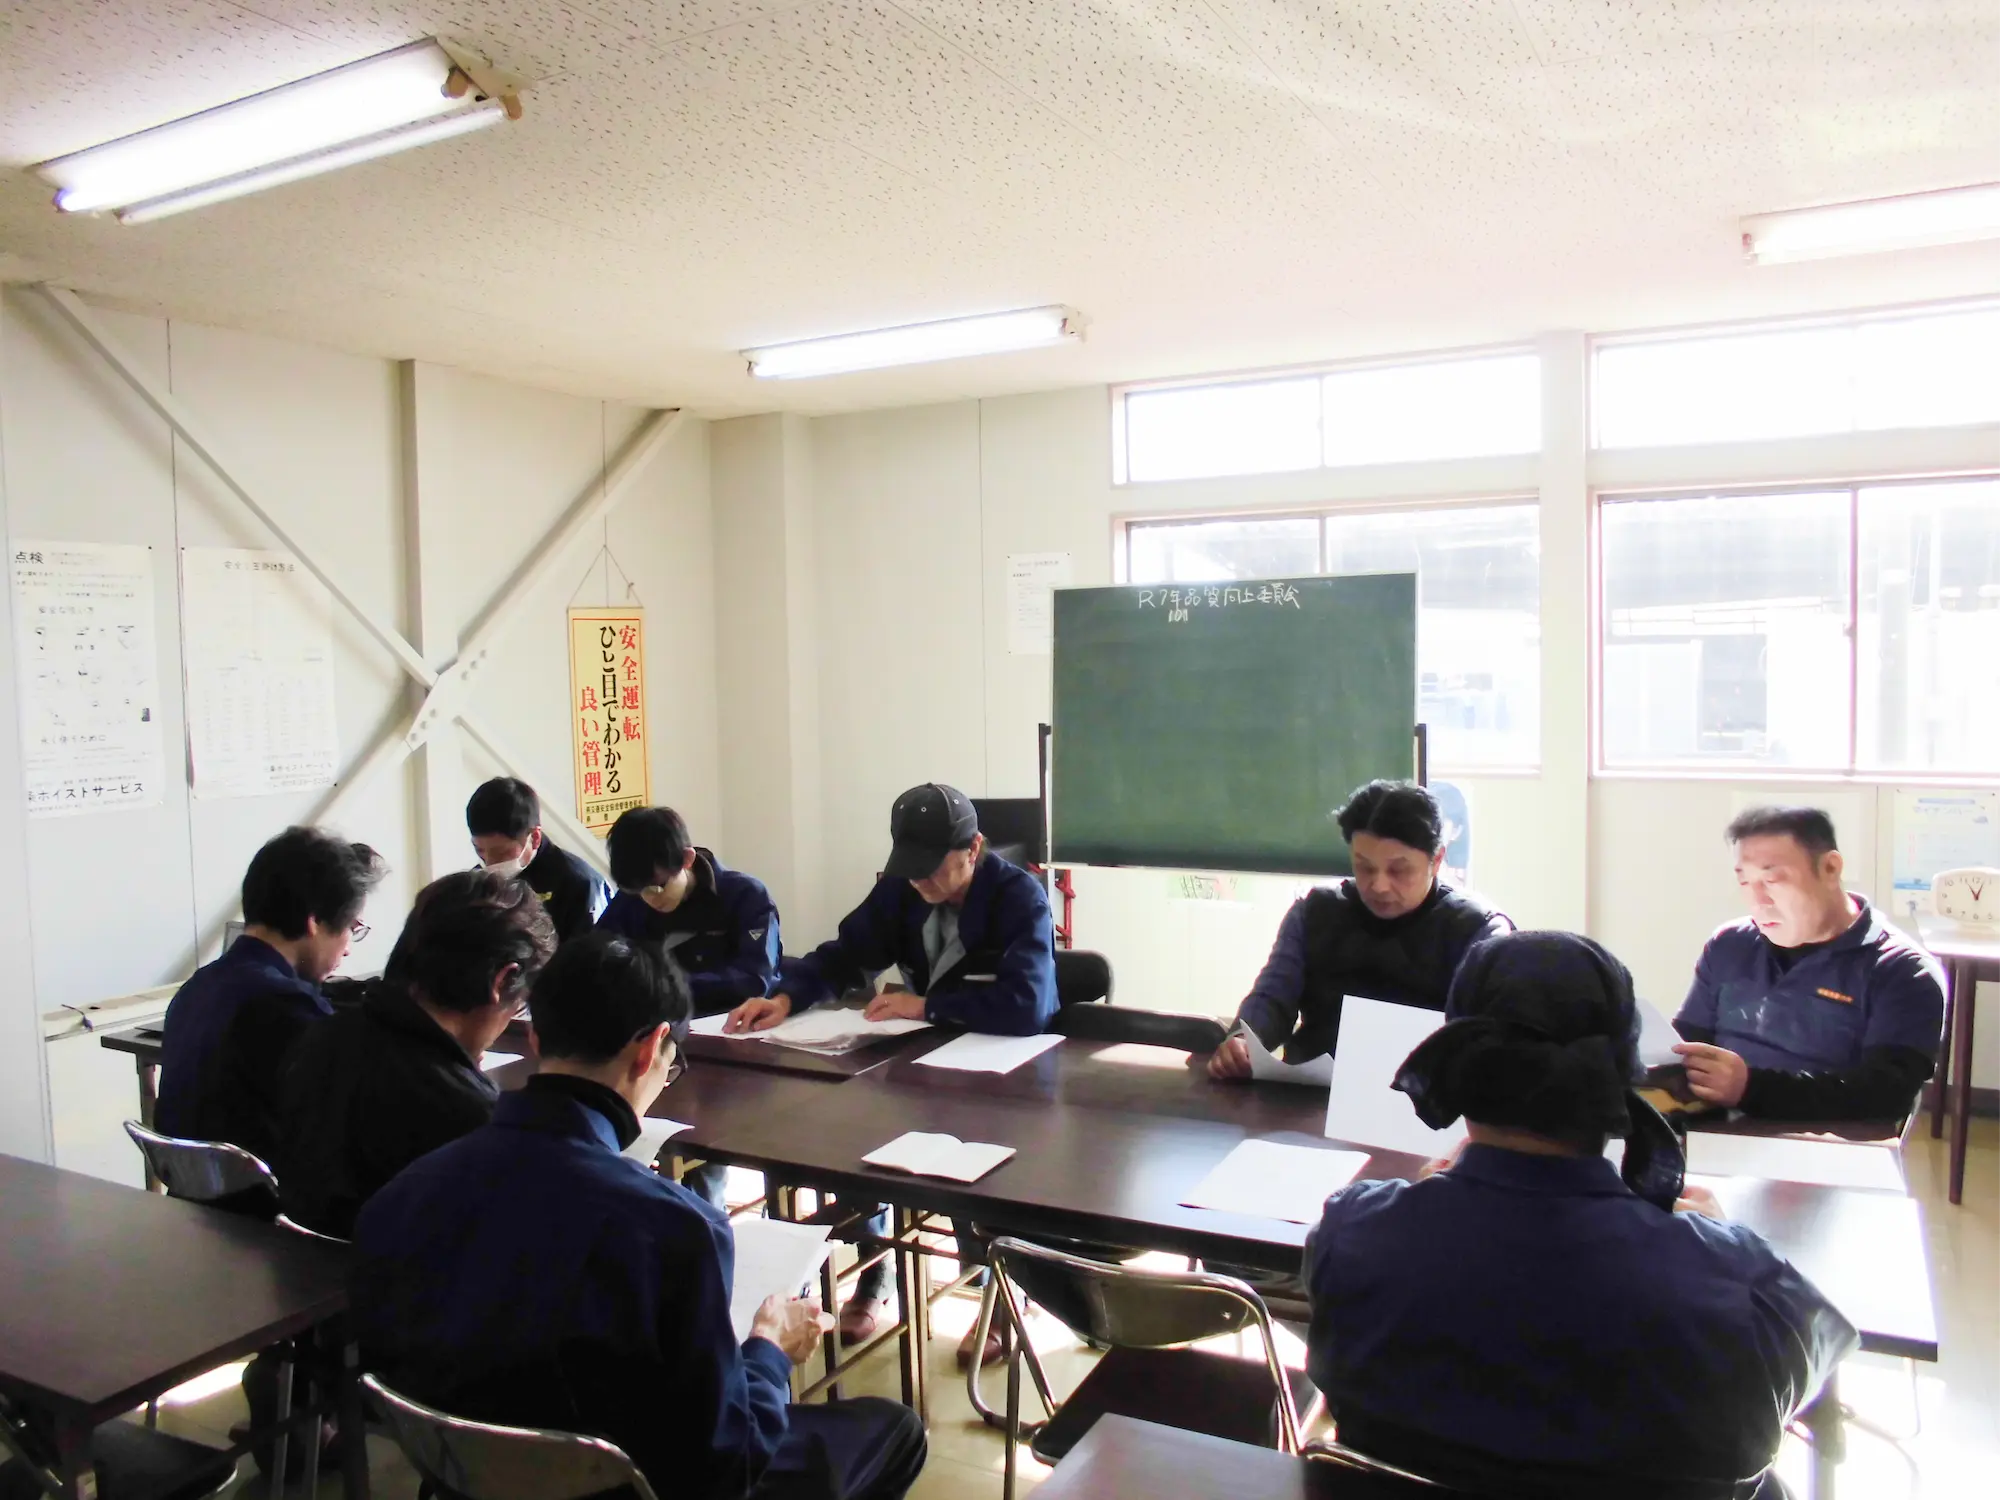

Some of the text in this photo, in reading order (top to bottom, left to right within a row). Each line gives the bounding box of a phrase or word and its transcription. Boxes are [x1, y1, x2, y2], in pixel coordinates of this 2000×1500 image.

[15, 551, 44, 564] 点検
[600, 625, 622, 793] ひと目でわかる
[619, 624, 641, 741] 安全運転
[580, 685, 603, 796] 良い管理
